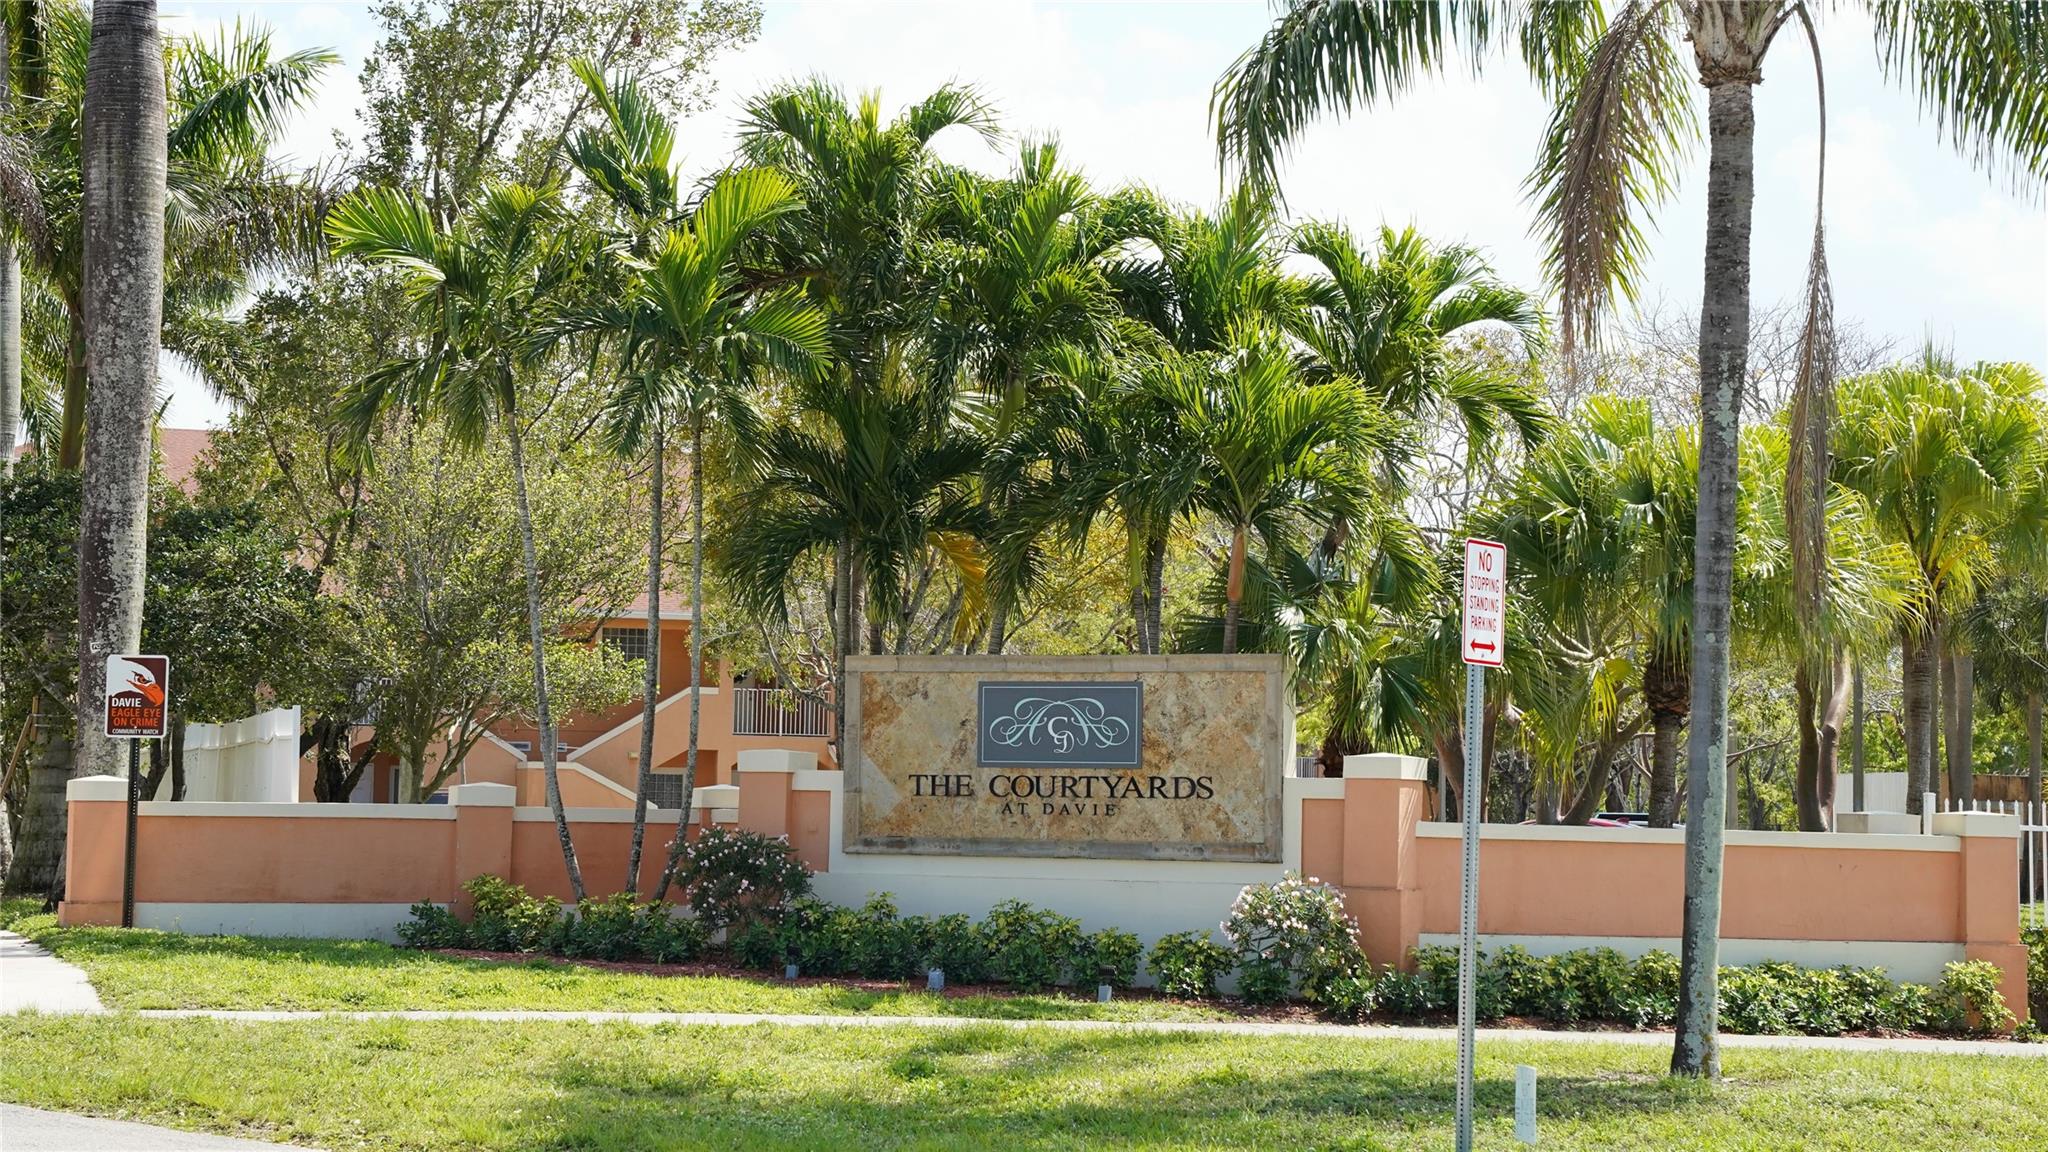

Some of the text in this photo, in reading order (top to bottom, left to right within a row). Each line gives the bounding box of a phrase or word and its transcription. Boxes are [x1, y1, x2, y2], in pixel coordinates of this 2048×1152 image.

[1479, 551, 1493, 572] NO
[1470, 575, 1499, 593] STOPPING
[1470, 595, 1499, 613] STANDING
[1471, 615, 1497, 633] PARKING
[111, 697, 142, 707] DAVIE
[111, 708, 161, 717] EAGLE EYE
[113, 717, 159, 727] ON CRIME
[908, 774, 1214, 800] THE COURTYARDS
[1001, 802, 1117, 817] AT DAVIE
